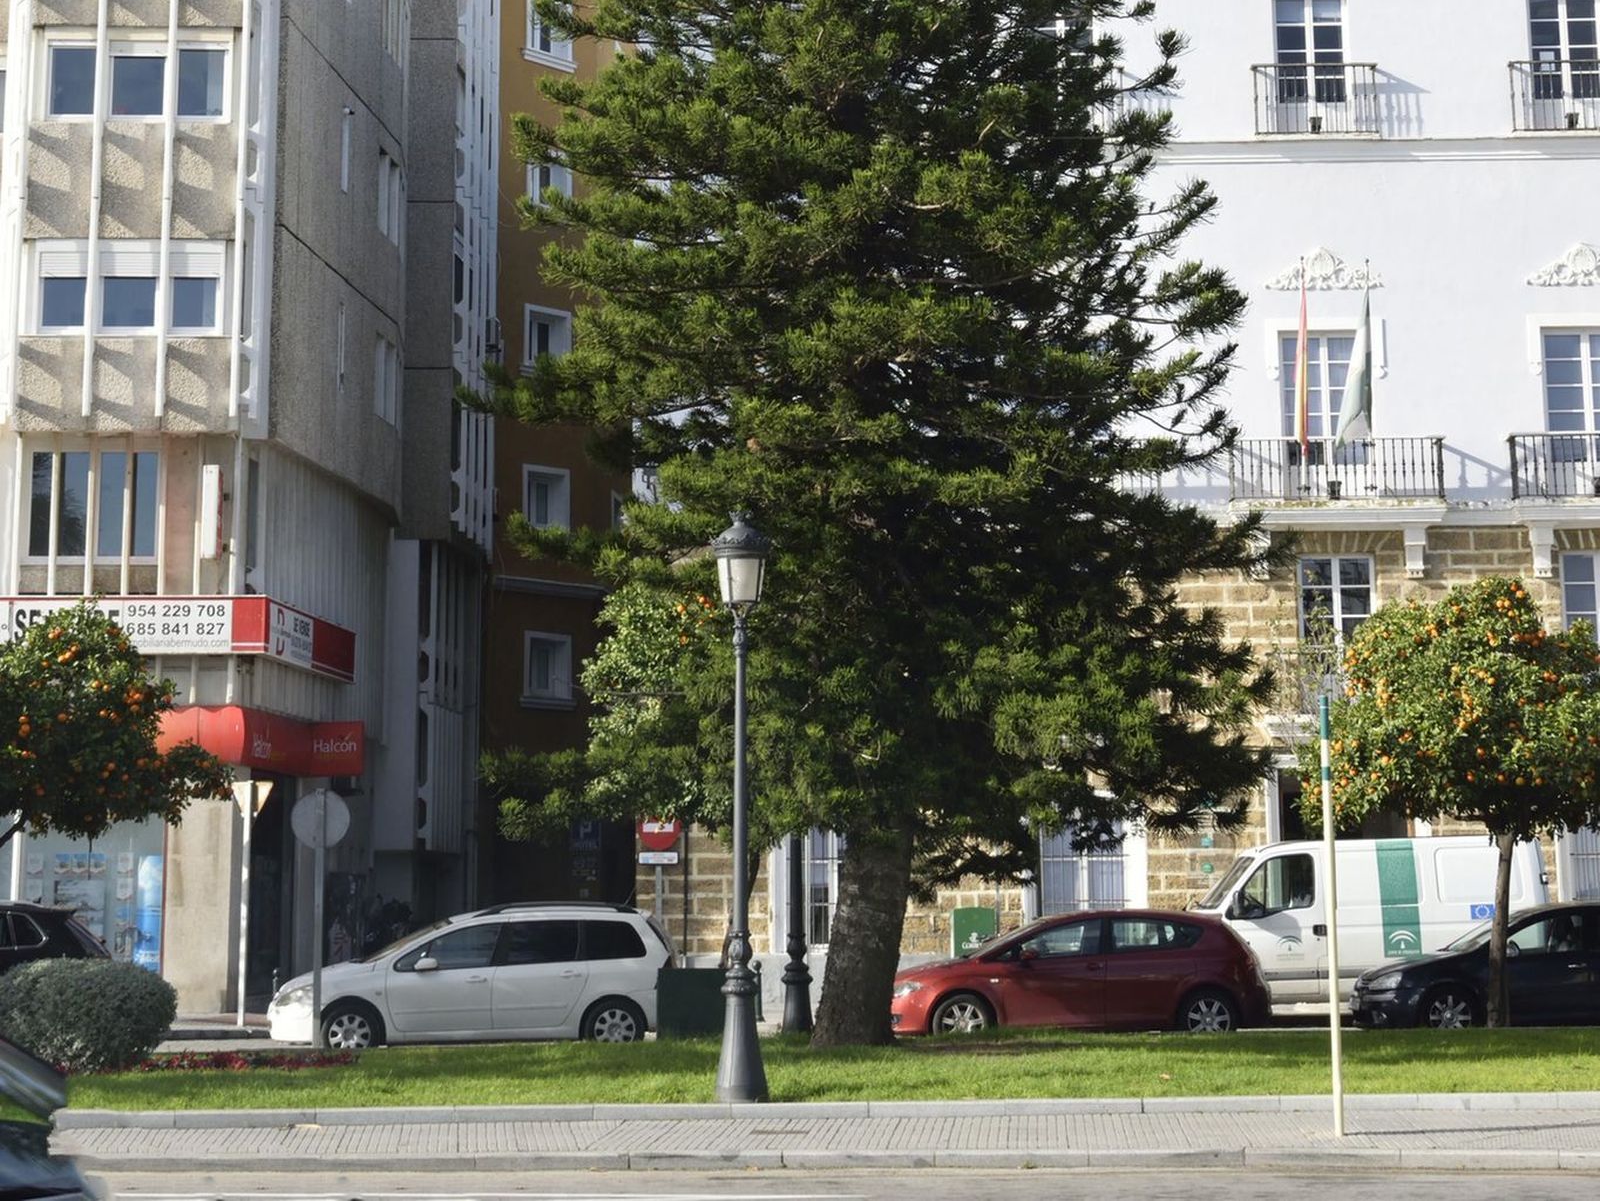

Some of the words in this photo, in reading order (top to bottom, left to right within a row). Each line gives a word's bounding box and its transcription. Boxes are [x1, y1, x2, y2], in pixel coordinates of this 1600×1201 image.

[127, 604, 156, 617] 954
[162, 604, 191, 617] 229
[197, 604, 226, 617] 708
[126, 622, 156, 635] 685
[161, 622, 189, 635] 841
[196, 622, 225, 635] 827
